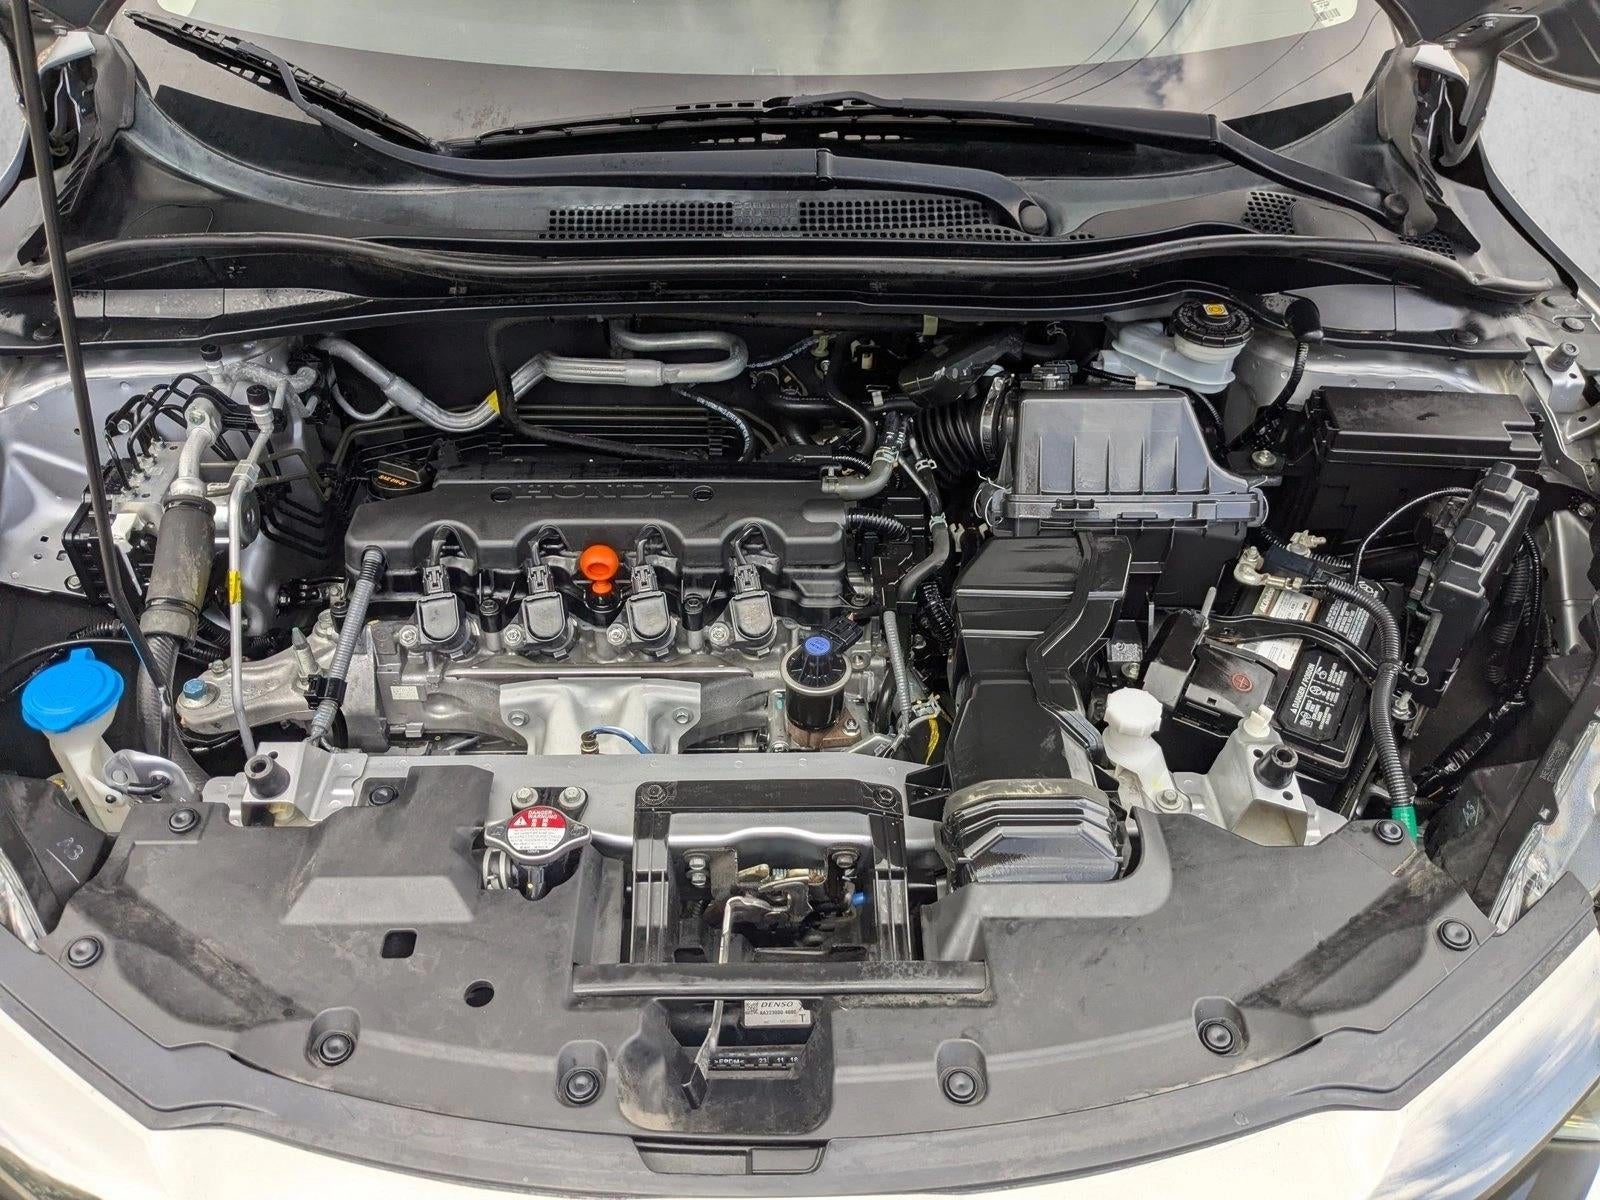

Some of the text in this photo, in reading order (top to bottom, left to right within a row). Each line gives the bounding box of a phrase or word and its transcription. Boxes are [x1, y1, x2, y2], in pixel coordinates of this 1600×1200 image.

[514, 484, 690, 499] HONDA
[1291, 685, 1307, 709] DANGER
[1302, 662, 1315, 681] POISON
[760, 1000, 794, 1008] DENSO
